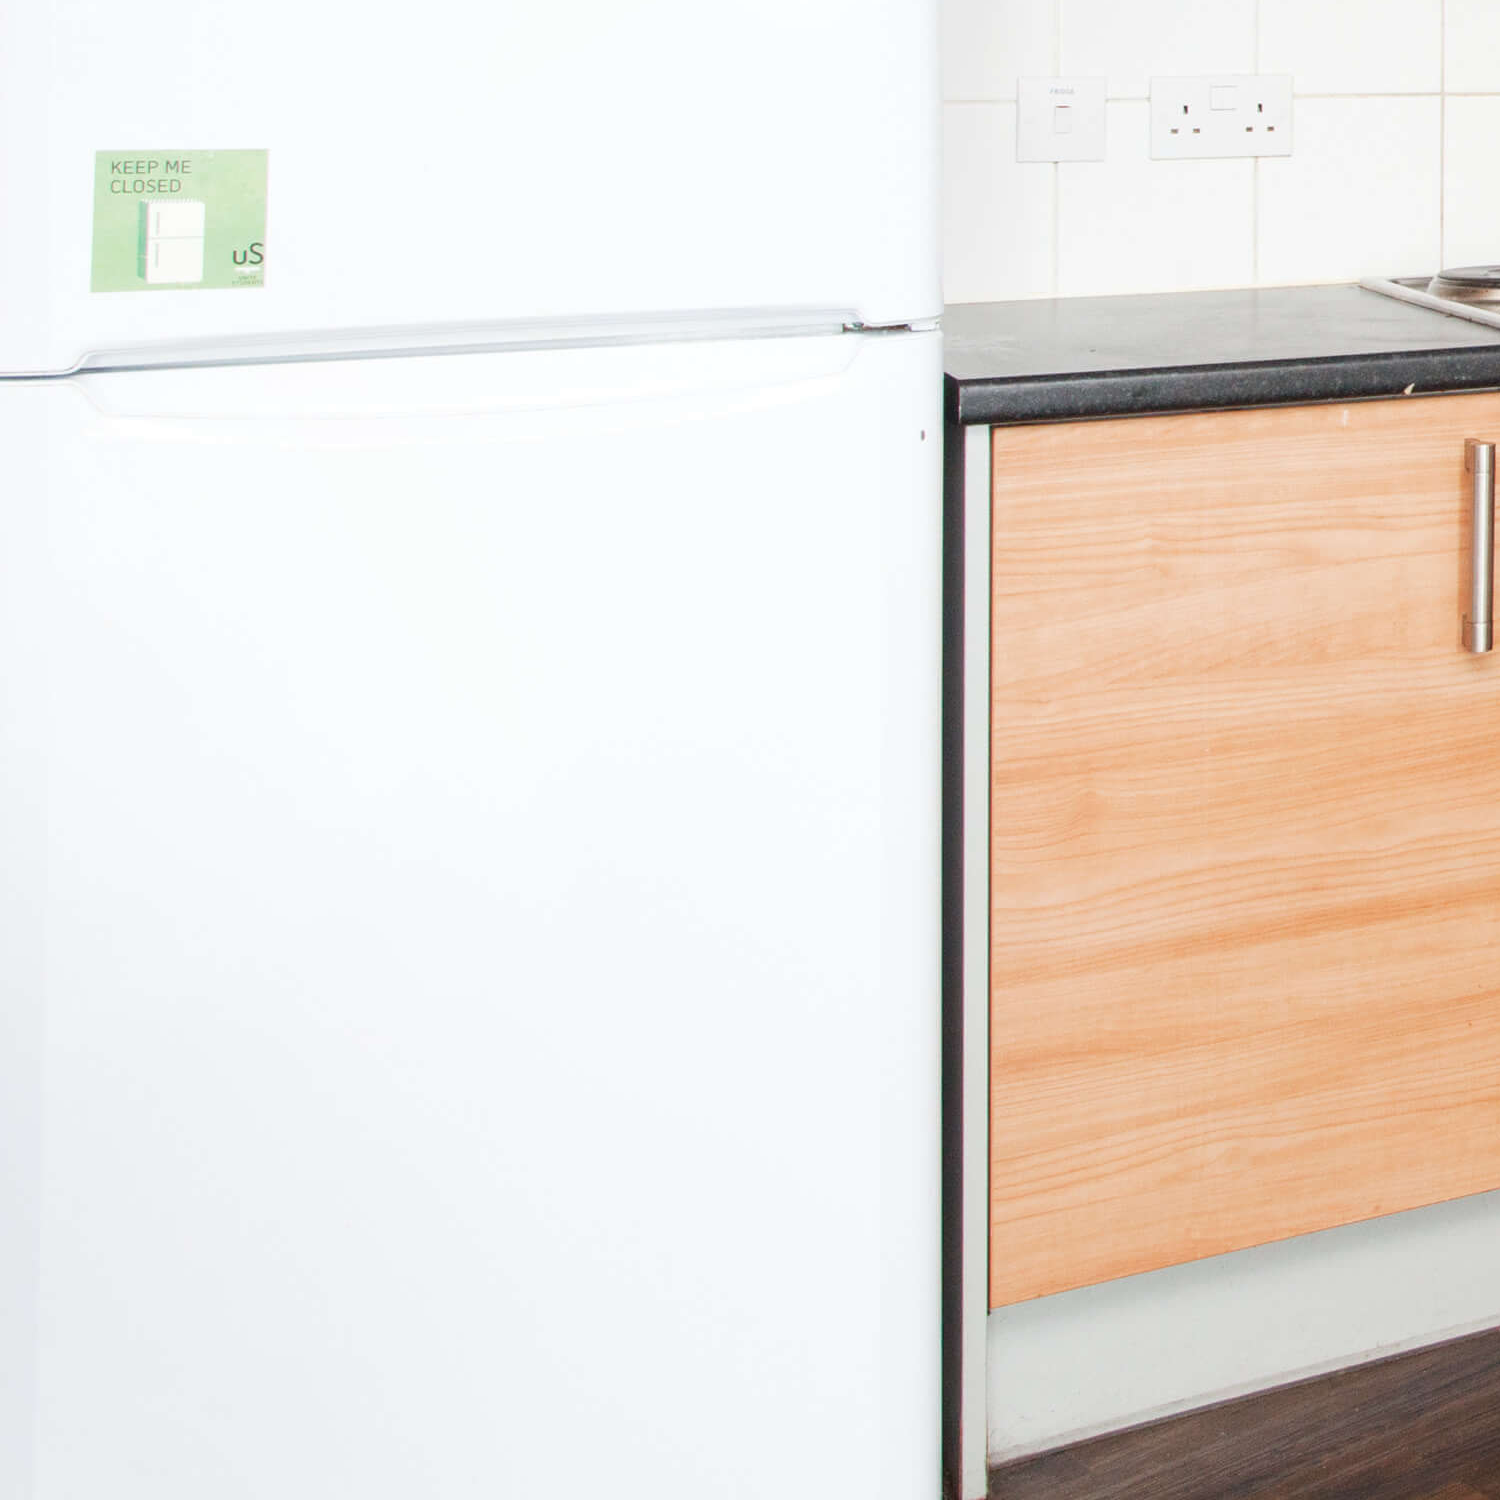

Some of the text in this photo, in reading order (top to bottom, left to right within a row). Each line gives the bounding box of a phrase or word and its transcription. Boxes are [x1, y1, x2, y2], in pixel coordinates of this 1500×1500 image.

[111, 160, 192, 174] KEEP ME
[111, 179, 182, 193] CLOSED
